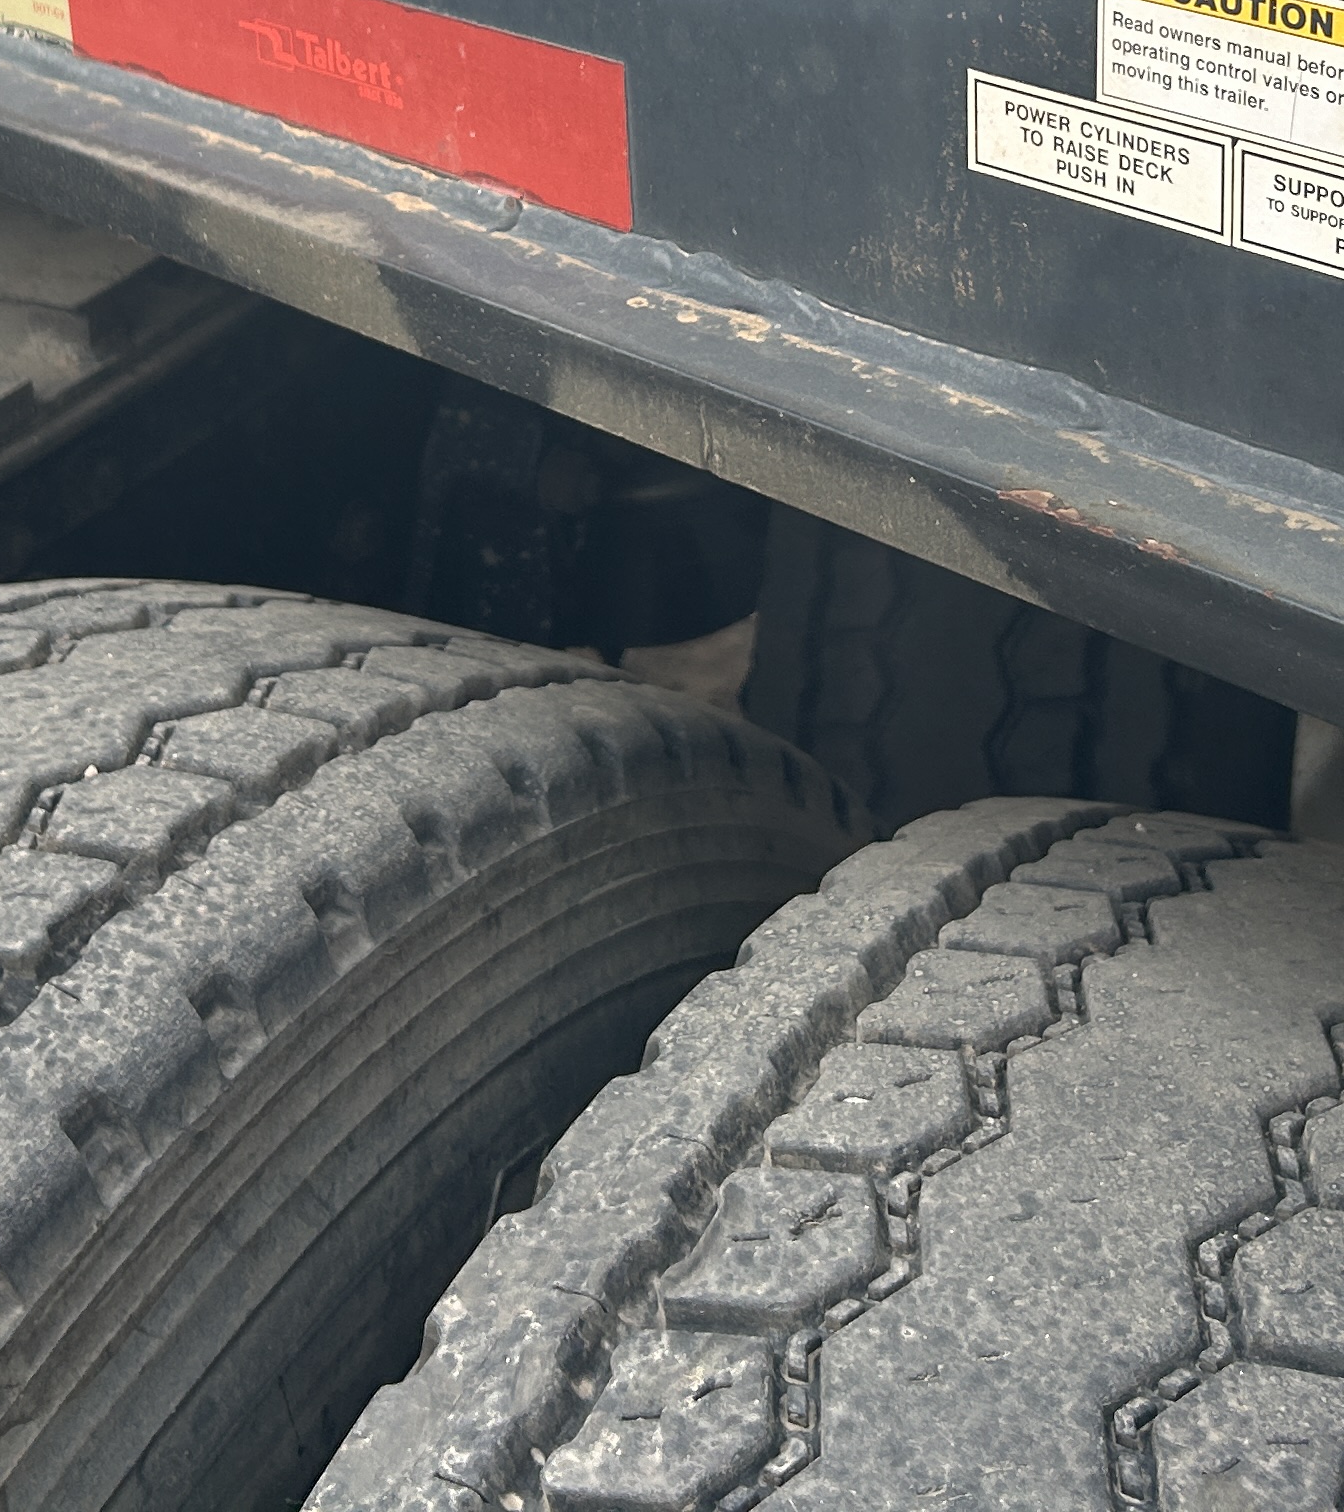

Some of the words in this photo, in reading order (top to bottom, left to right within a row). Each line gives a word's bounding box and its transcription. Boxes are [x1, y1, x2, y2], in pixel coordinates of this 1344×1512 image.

[1112, 10, 1153, 35] Read
[1159, 25, 1221, 51] owners
[1227, 39, 1291, 68] manual
[1112, 38, 1190, 71] operating
[1196, 56, 1257, 84] control
[1263, 73, 1320, 100] valves
[1326, 90, 1344, 106] or
[1112, 61, 1172, 90] moving
[1178, 72, 1209, 96] this
[1214, 86, 1269, 112] trailer.
[1005, 100, 1071, 132] POWER
[1080, 121, 1190, 165] CYLINDERS
[1020, 127, 1043, 147] TO
[1053, 136, 1109, 166] RAISE
[1119, 154, 1174, 184] DECK
[1056, 159, 1106, 188] PUSH
[1116, 176, 1135, 196] IN
[1266, 197, 1285, 213] TO
